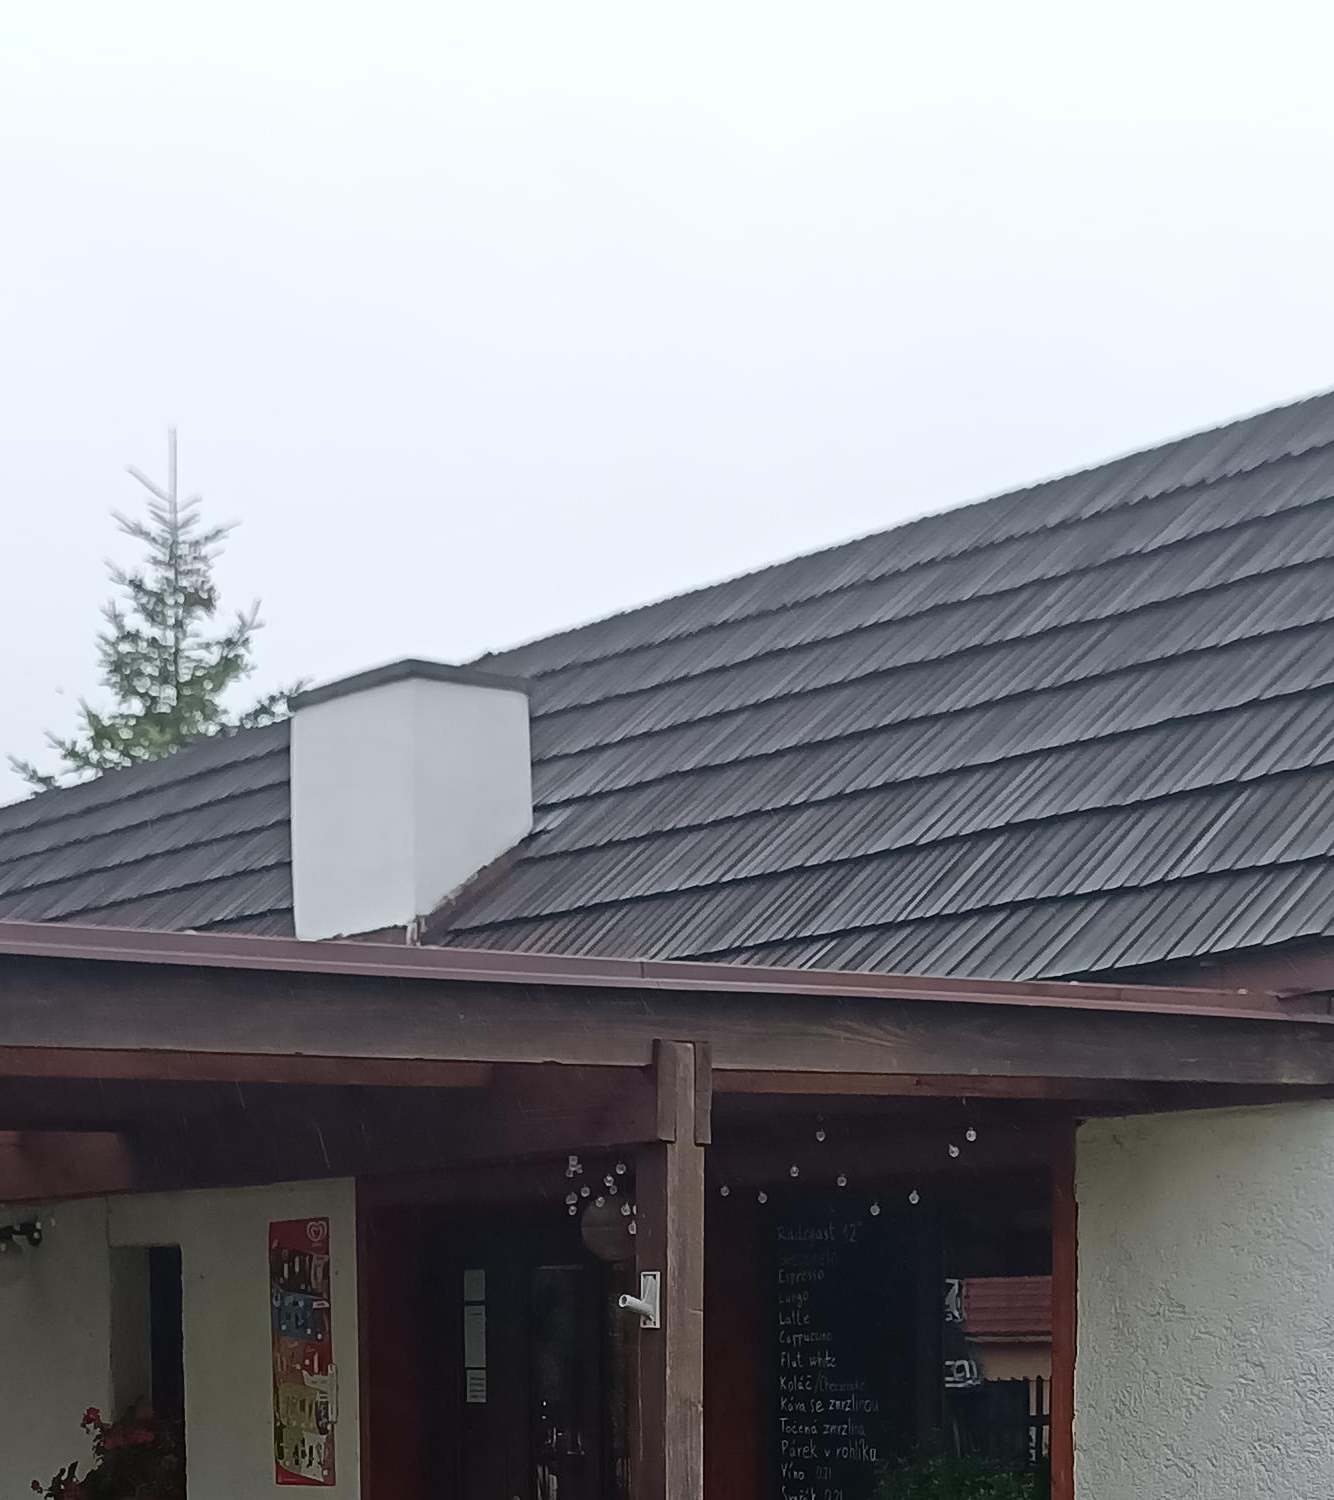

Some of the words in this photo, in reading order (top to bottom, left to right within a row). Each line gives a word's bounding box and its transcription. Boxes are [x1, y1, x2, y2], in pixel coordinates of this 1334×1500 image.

[810, 1398, 825, 1413] se
[779, 1417, 818, 1435] Točená
[781, 1439, 819, 1459] Párek
